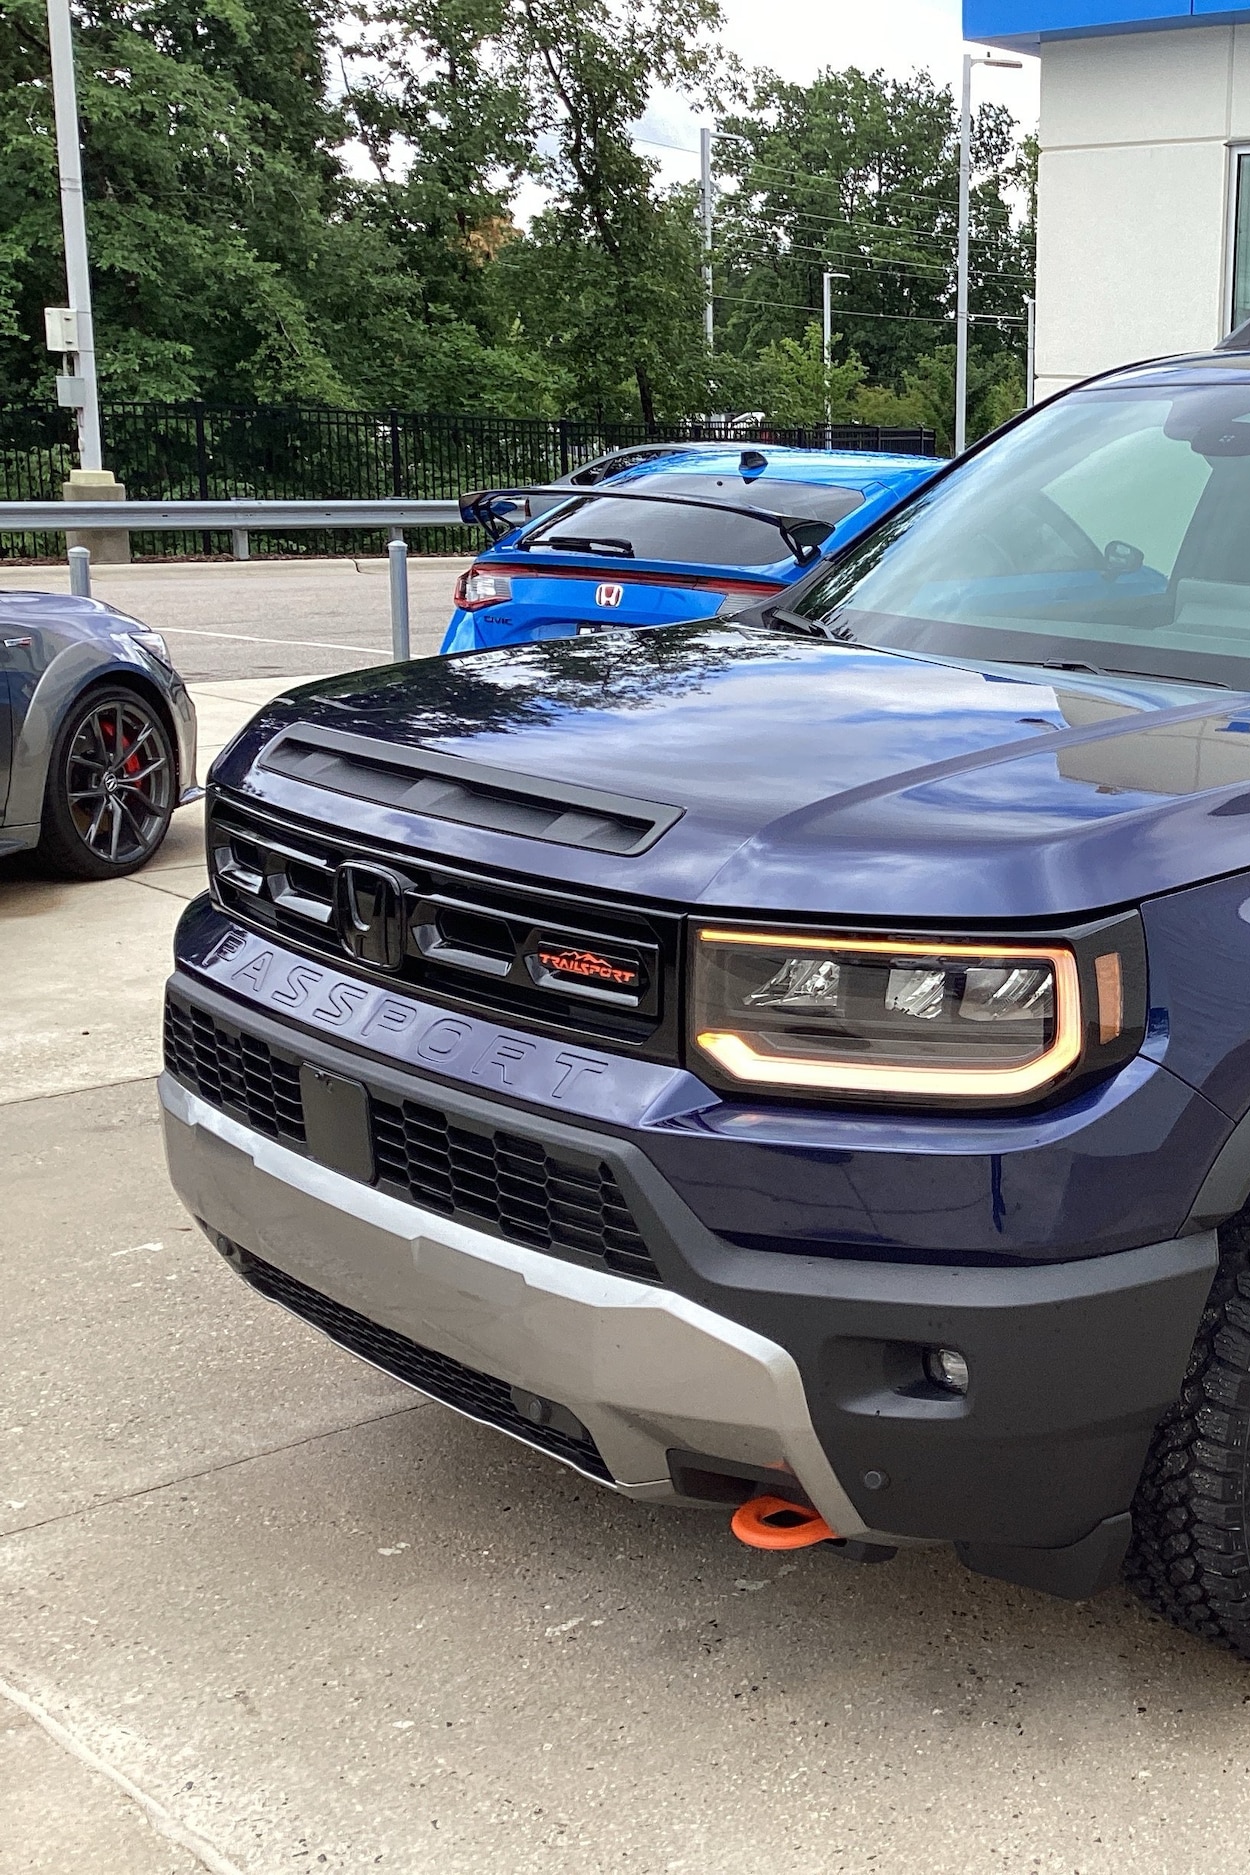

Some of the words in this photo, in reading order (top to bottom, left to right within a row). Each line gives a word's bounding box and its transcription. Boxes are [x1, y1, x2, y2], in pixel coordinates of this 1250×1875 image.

[484, 615, 513, 626] CIVIC
[539, 953, 635, 983] TRAILSPORT
[201, 930, 609, 1099] PASSPORT
